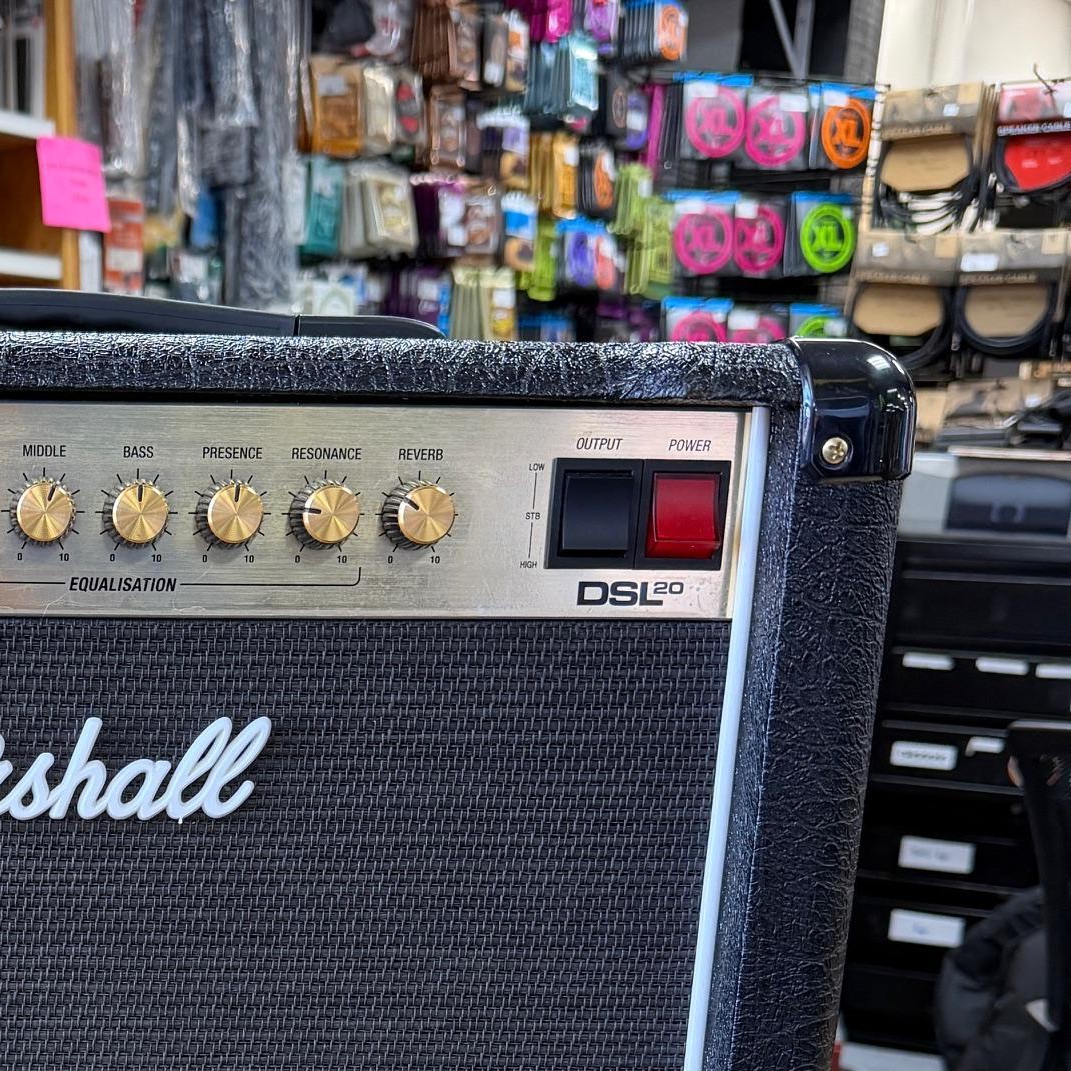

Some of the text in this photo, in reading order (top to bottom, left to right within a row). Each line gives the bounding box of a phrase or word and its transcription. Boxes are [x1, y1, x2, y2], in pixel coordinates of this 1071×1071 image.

[576, 437, 624, 451] OUTPUT
[668, 438, 712, 452] POWER
[22, 444, 66, 458] MIDDLE
[123, 445, 154, 459] BASS
[202, 446, 263, 460] PRESENCE
[291, 447, 362, 460] RESONANCE
[398, 448, 444, 461] REVERB
[528, 462, 545, 472] LOW
[525, 511, 541, 520] STB
[17, 552, 70, 562] 0 10
[109, 553, 162, 563] 0 10
[202, 554, 255, 563] 0 10
[294, 554, 348, 564] 0 10
[387, 555, 441, 564] 0 10
[519, 560, 538, 569] HIGH
[69, 576, 177, 593] EQUALISATION
